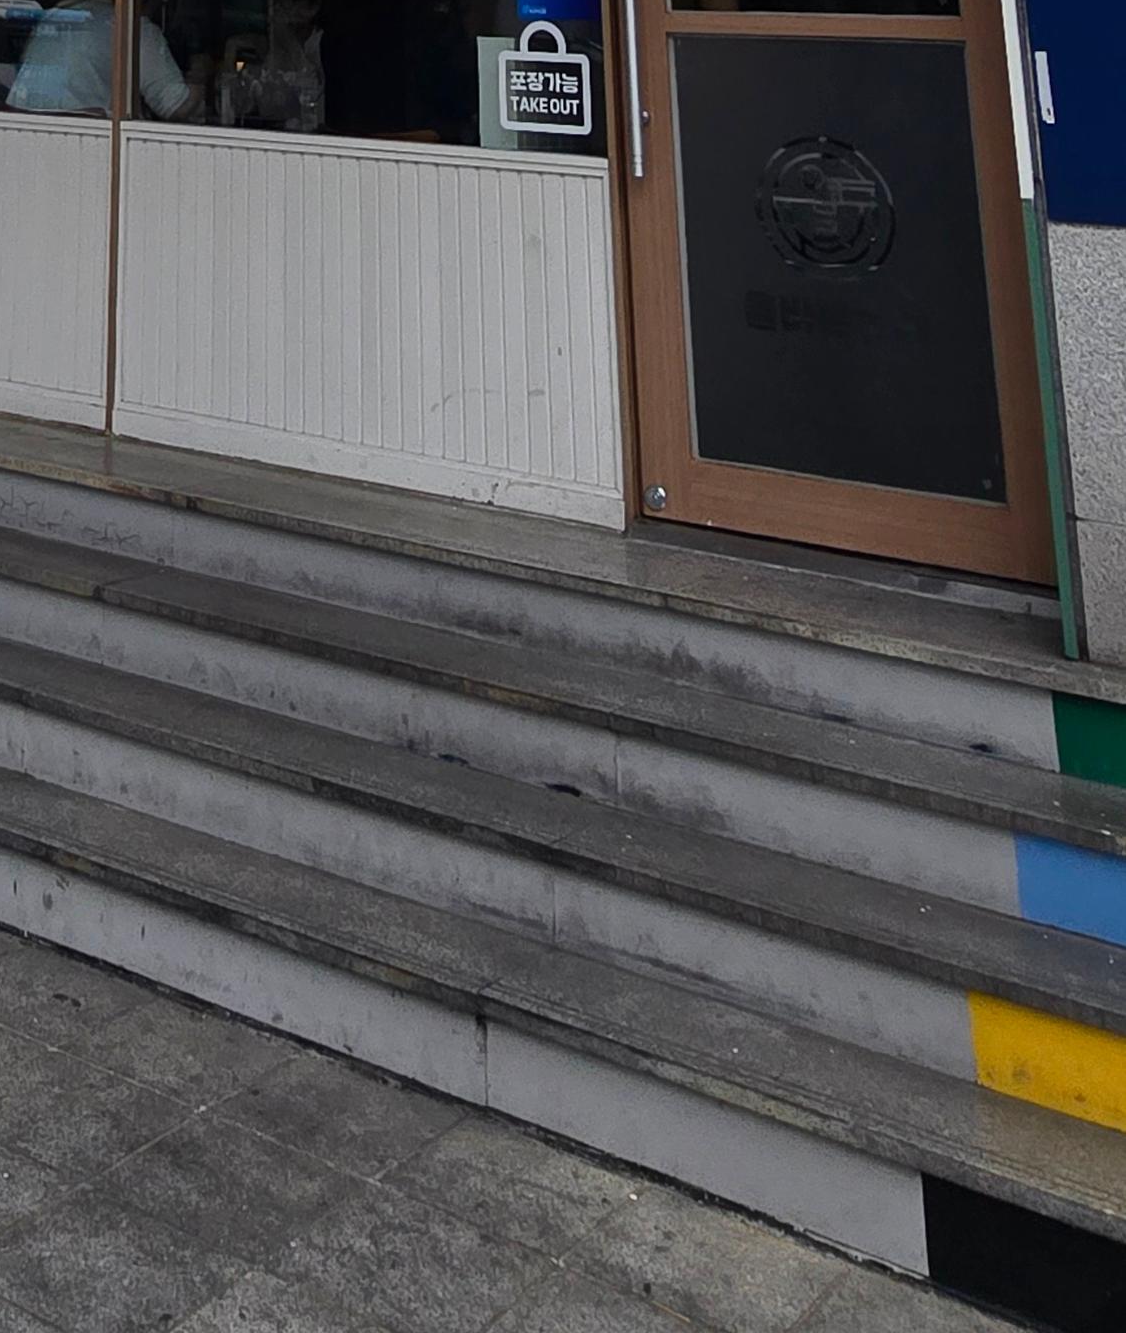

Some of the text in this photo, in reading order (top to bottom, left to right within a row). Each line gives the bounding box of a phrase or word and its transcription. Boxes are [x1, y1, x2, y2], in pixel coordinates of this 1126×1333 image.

[509, 70, 579, 94] 포장가능
[510, 96, 580, 116] TAKE OUT
